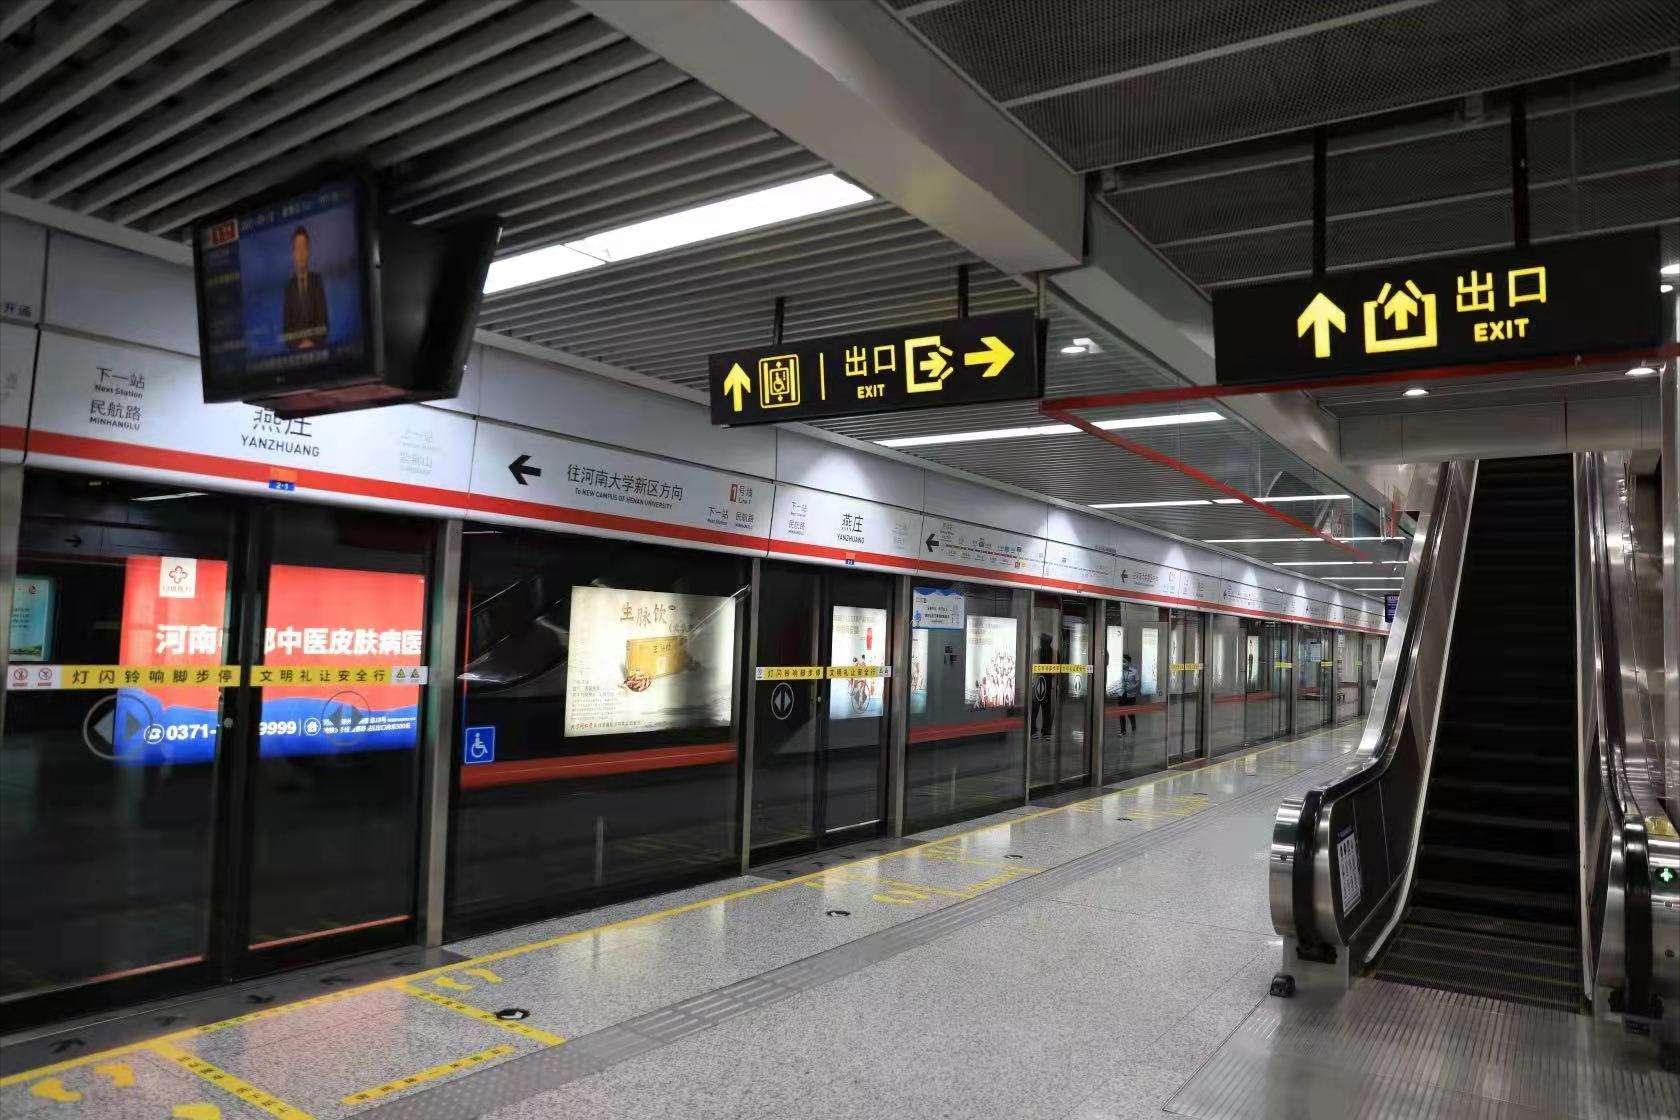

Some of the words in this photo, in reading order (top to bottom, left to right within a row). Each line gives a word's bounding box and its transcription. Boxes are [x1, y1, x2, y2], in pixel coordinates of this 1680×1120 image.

[1456, 266, 1546, 312] 出口
[1474, 318, 1530, 343] EXIT
[845, 345, 896, 377] 出口
[95, 366, 145, 389] 下一站
[95, 385, 113, 394] Next
[115, 387, 143, 399] Station
[857, 383, 885, 399] EXIT
[90, 399, 141, 421] 民航路
[241, 432, 319, 457] YANZHUANG
[567, 463, 684, 502] 往河南大学新区方向
[582, 488, 595, 497] NEW
[596, 490, 619, 501] CAMPUS
[626, 496, 644, 506] HENAN
[644, 500, 673, 510] UNIVERSITY
[707, 506, 729, 520] 下一站
[840, 513, 864, 533] 燕庄
[156, 624, 224, 656] 河南
[72, 668, 234, 685] 灯闪铃响脚步停
[260, 668, 386, 683] 文明礼让安全行
